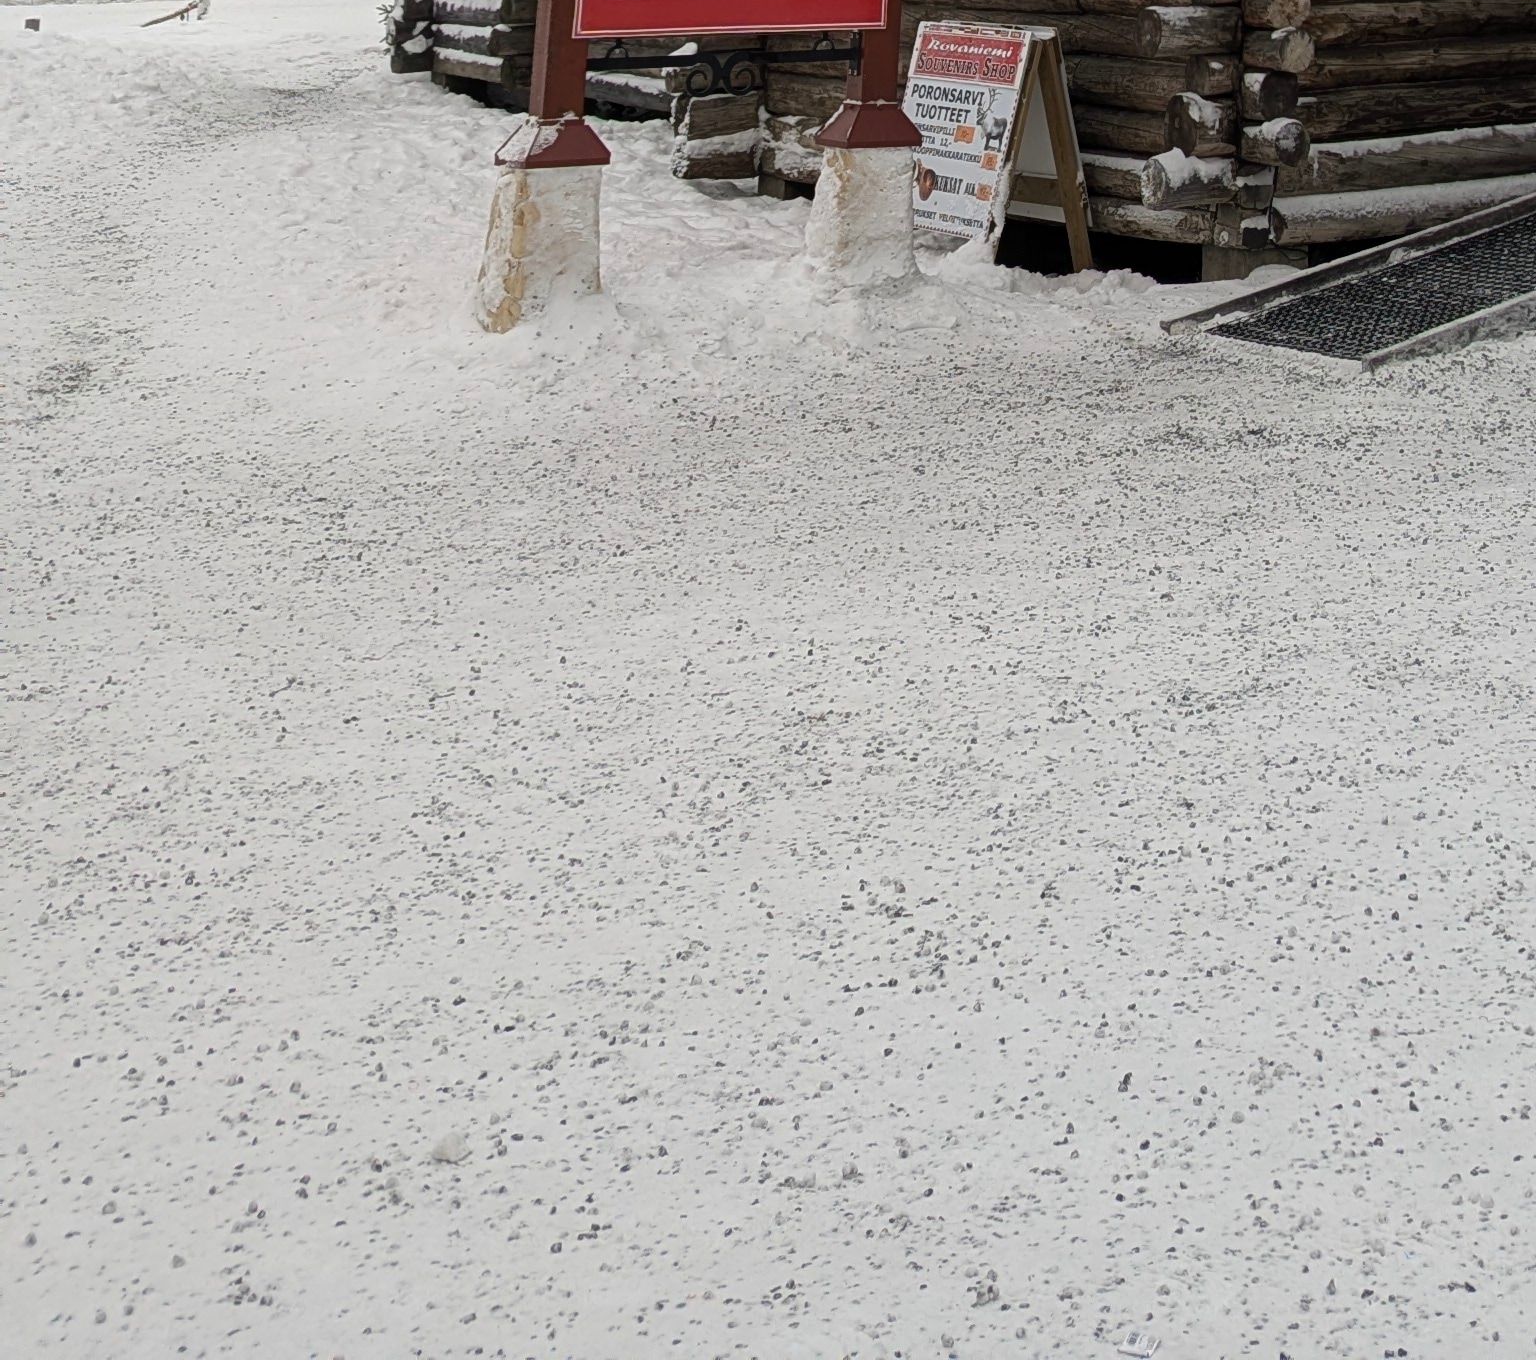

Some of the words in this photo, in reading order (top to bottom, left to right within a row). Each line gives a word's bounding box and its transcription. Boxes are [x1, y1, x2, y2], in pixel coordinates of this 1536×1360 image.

[927, 37, 1013, 59] Rovaniemi
[917, 51, 979, 76] SOUVENIRS
[982, 57, 1016, 80] SHOP
[911, 83, 985, 107] PORONSARVI
[915, 103, 971, 124] TUOTTEET
